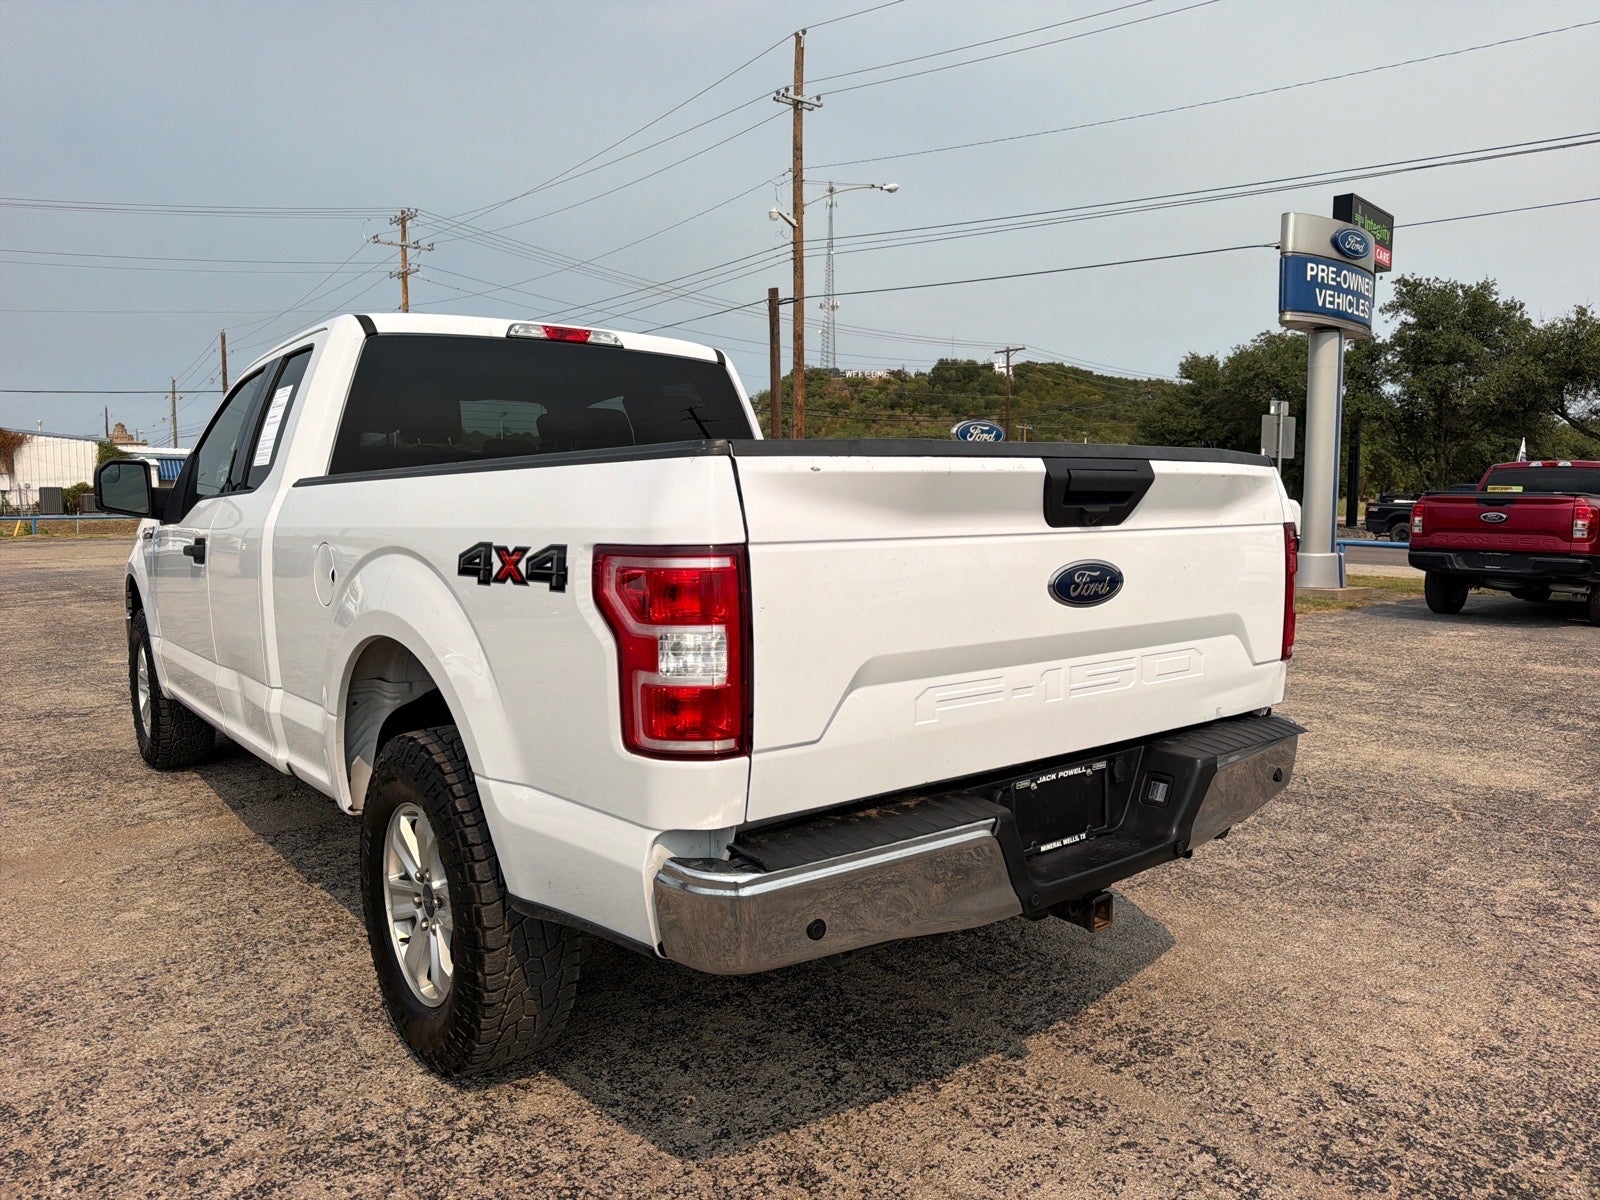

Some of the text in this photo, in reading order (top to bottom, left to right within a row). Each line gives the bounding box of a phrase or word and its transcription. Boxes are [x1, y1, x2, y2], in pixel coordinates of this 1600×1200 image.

[1345, 235, 1365, 252] Ford
[1376, 248, 1390, 264] CARE
[1307, 262, 1373, 299] PRE-OWNED
[1316, 287, 1370, 319] VEHICLES
[845, 369, 891, 379] WELCOME
[966, 424, 997, 442] Ford
[1436, 534, 1555, 546] RANGER
[1070, 570, 1111, 597] Ford
[914, 647, 1205, 726] F-150
[1037, 773, 1056, 783] JACK
[1058, 766, 1086, 778] POWELL
[1041, 841, 1062, 852] MINERAL
